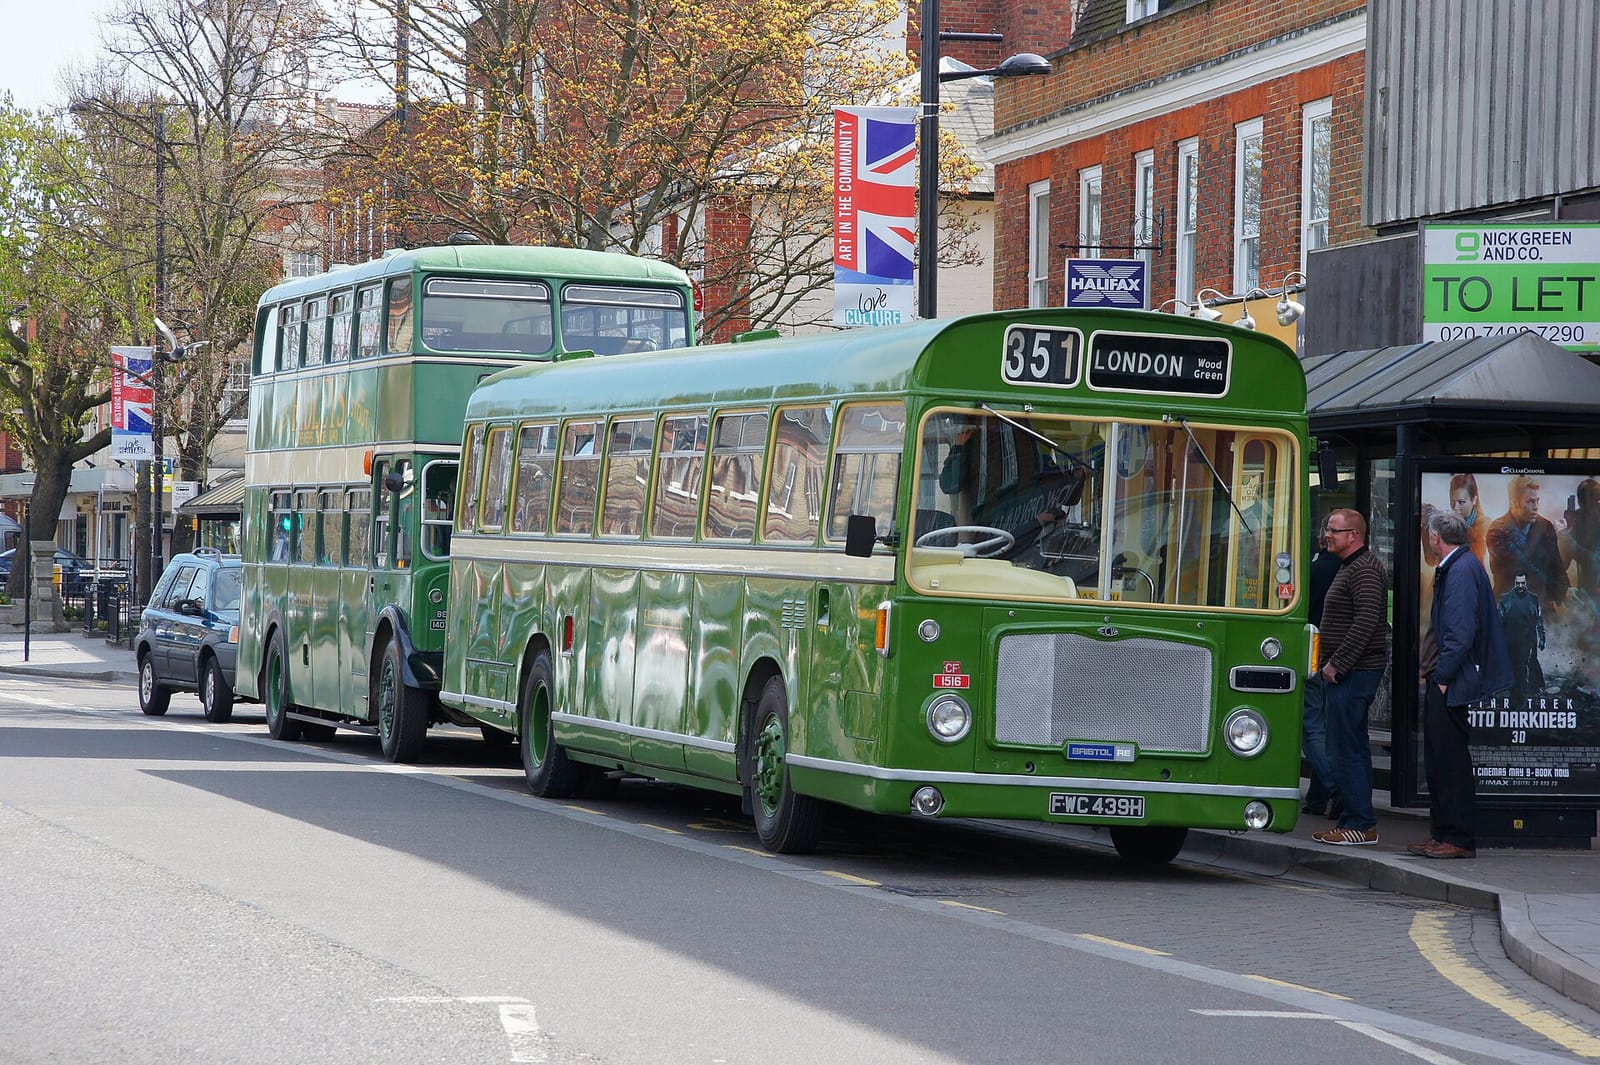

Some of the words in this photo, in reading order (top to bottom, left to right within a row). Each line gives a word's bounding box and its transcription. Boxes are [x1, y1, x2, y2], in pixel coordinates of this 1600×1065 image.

[838, 120, 853, 192] COMMUNITY
[838, 195, 852, 217] THE
[838, 221, 852, 234] IN
[1483, 231, 1518, 245] NICK
[1520, 231, 1572, 245] GREEN
[838, 237, 852, 261] ART
[1483, 247, 1515, 260] AND
[1518, 246, 1543, 260] CO.
[1071, 277, 1141, 291] HALIFAX
[1432, 276, 1492, 312] TO
[1511, 276, 1596, 312] LET
[845, 309, 900, 326] CULTURE
[1537, 325, 1585, 341] 7290
[1005, 330, 1074, 380] 351
[1094, 349, 1184, 377] LONDON
[1198, 358, 1222, 369] Wood
[1194, 369, 1223, 381] Green
[944, 663, 960, 673] CF
[941, 676, 962, 687] 1516
[1527, 698, 1573, 709] TREK
[1499, 711, 1577, 729] DARKNESS
[1511, 730, 1526, 744] 3D
[1071, 747, 1113, 757] BRISTOL
